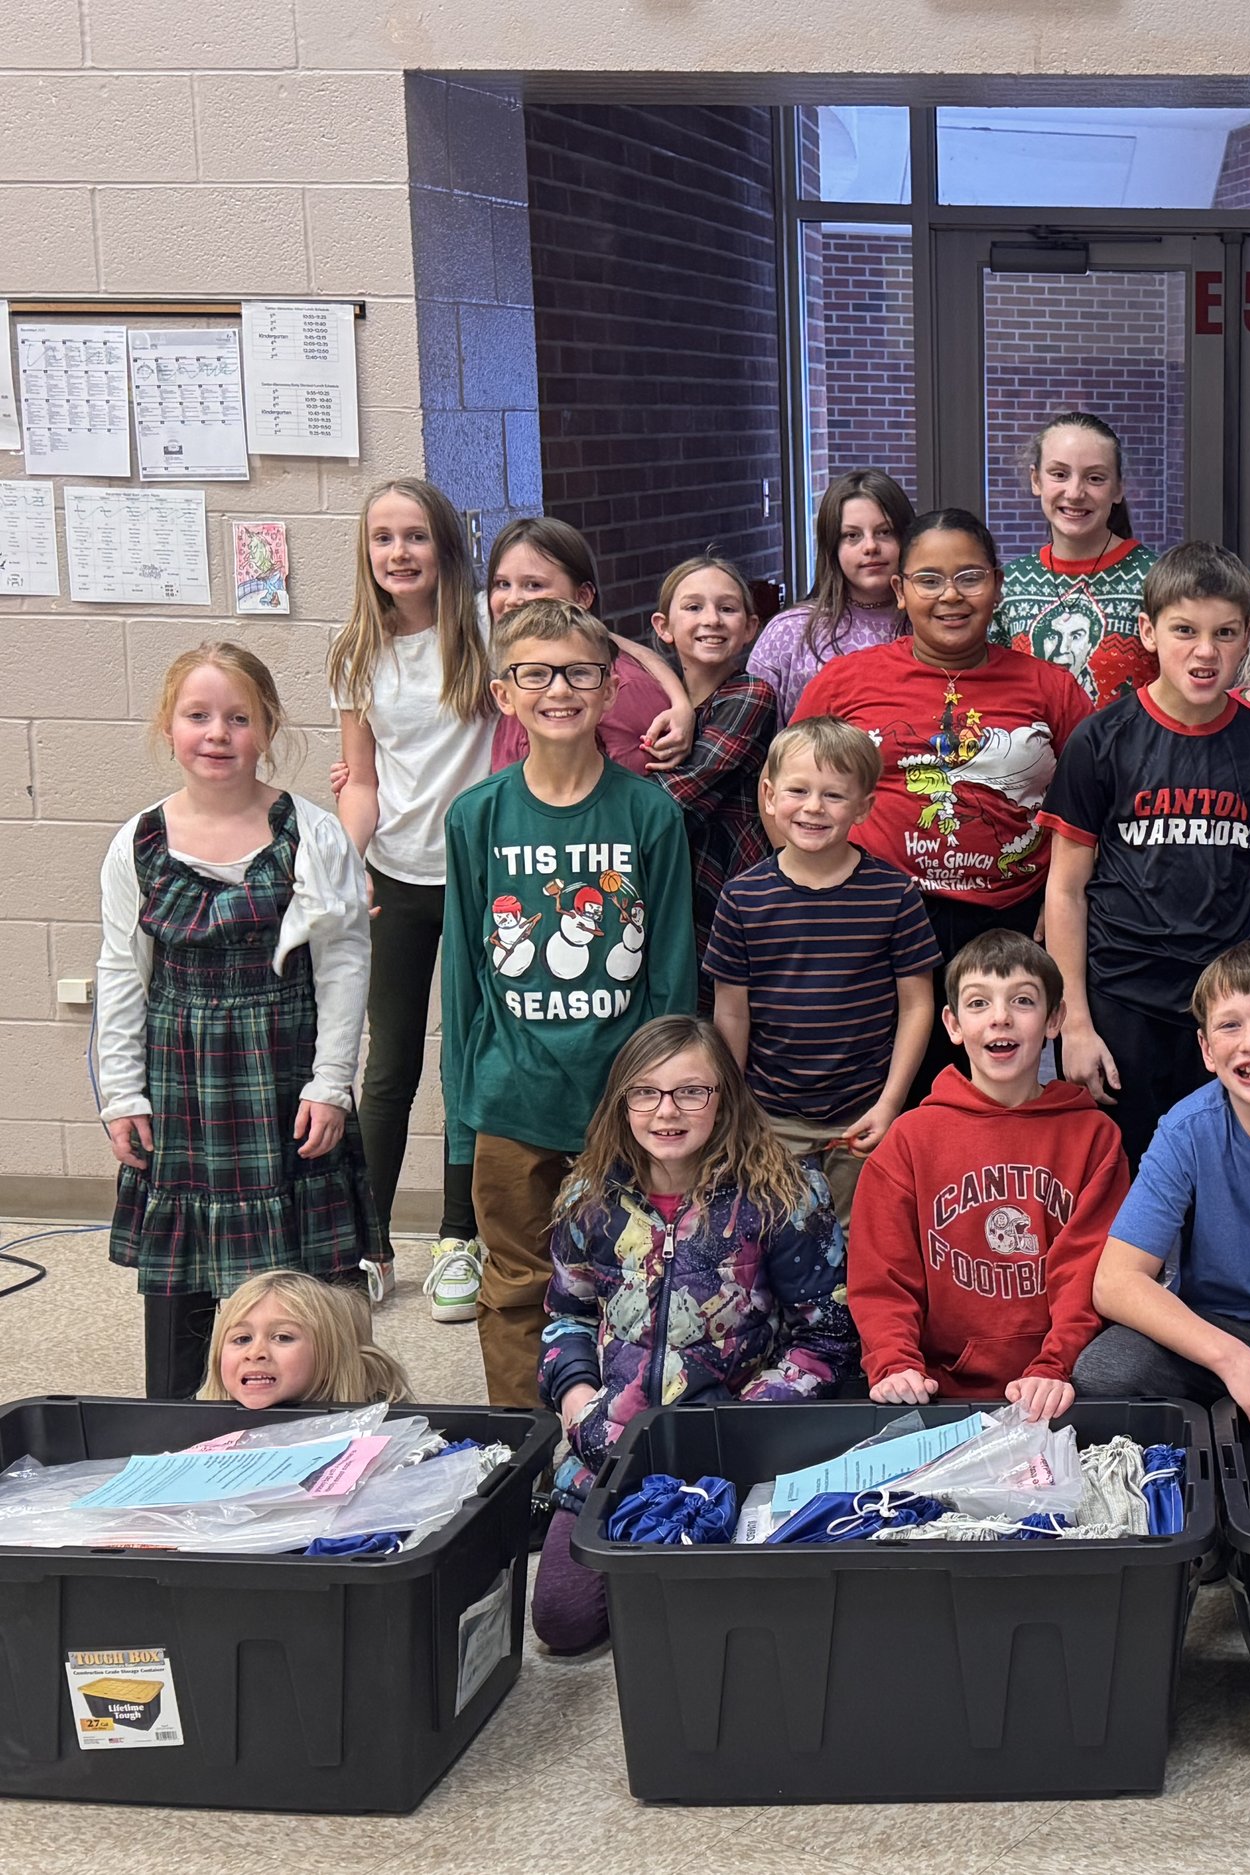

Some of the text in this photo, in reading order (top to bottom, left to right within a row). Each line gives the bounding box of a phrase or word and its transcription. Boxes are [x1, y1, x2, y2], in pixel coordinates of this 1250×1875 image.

[1195, 271, 1222, 334] E
[1134, 787, 1248, 821] CANTON
[494, 843, 633, 875] 'TIS THE
[943, 850, 994, 869] GRINCH
[926, 869, 965, 879] STOLE
[505, 989, 631, 1020] SEASON
[933, 1164, 1073, 1229] CANTON
[75, 1651, 159, 1666] TOUGH BOX
[108, 1704, 144, 1712] Lifetime
[114, 1711, 141, 1721] Tough
[86, 1719, 100, 1727] 27
